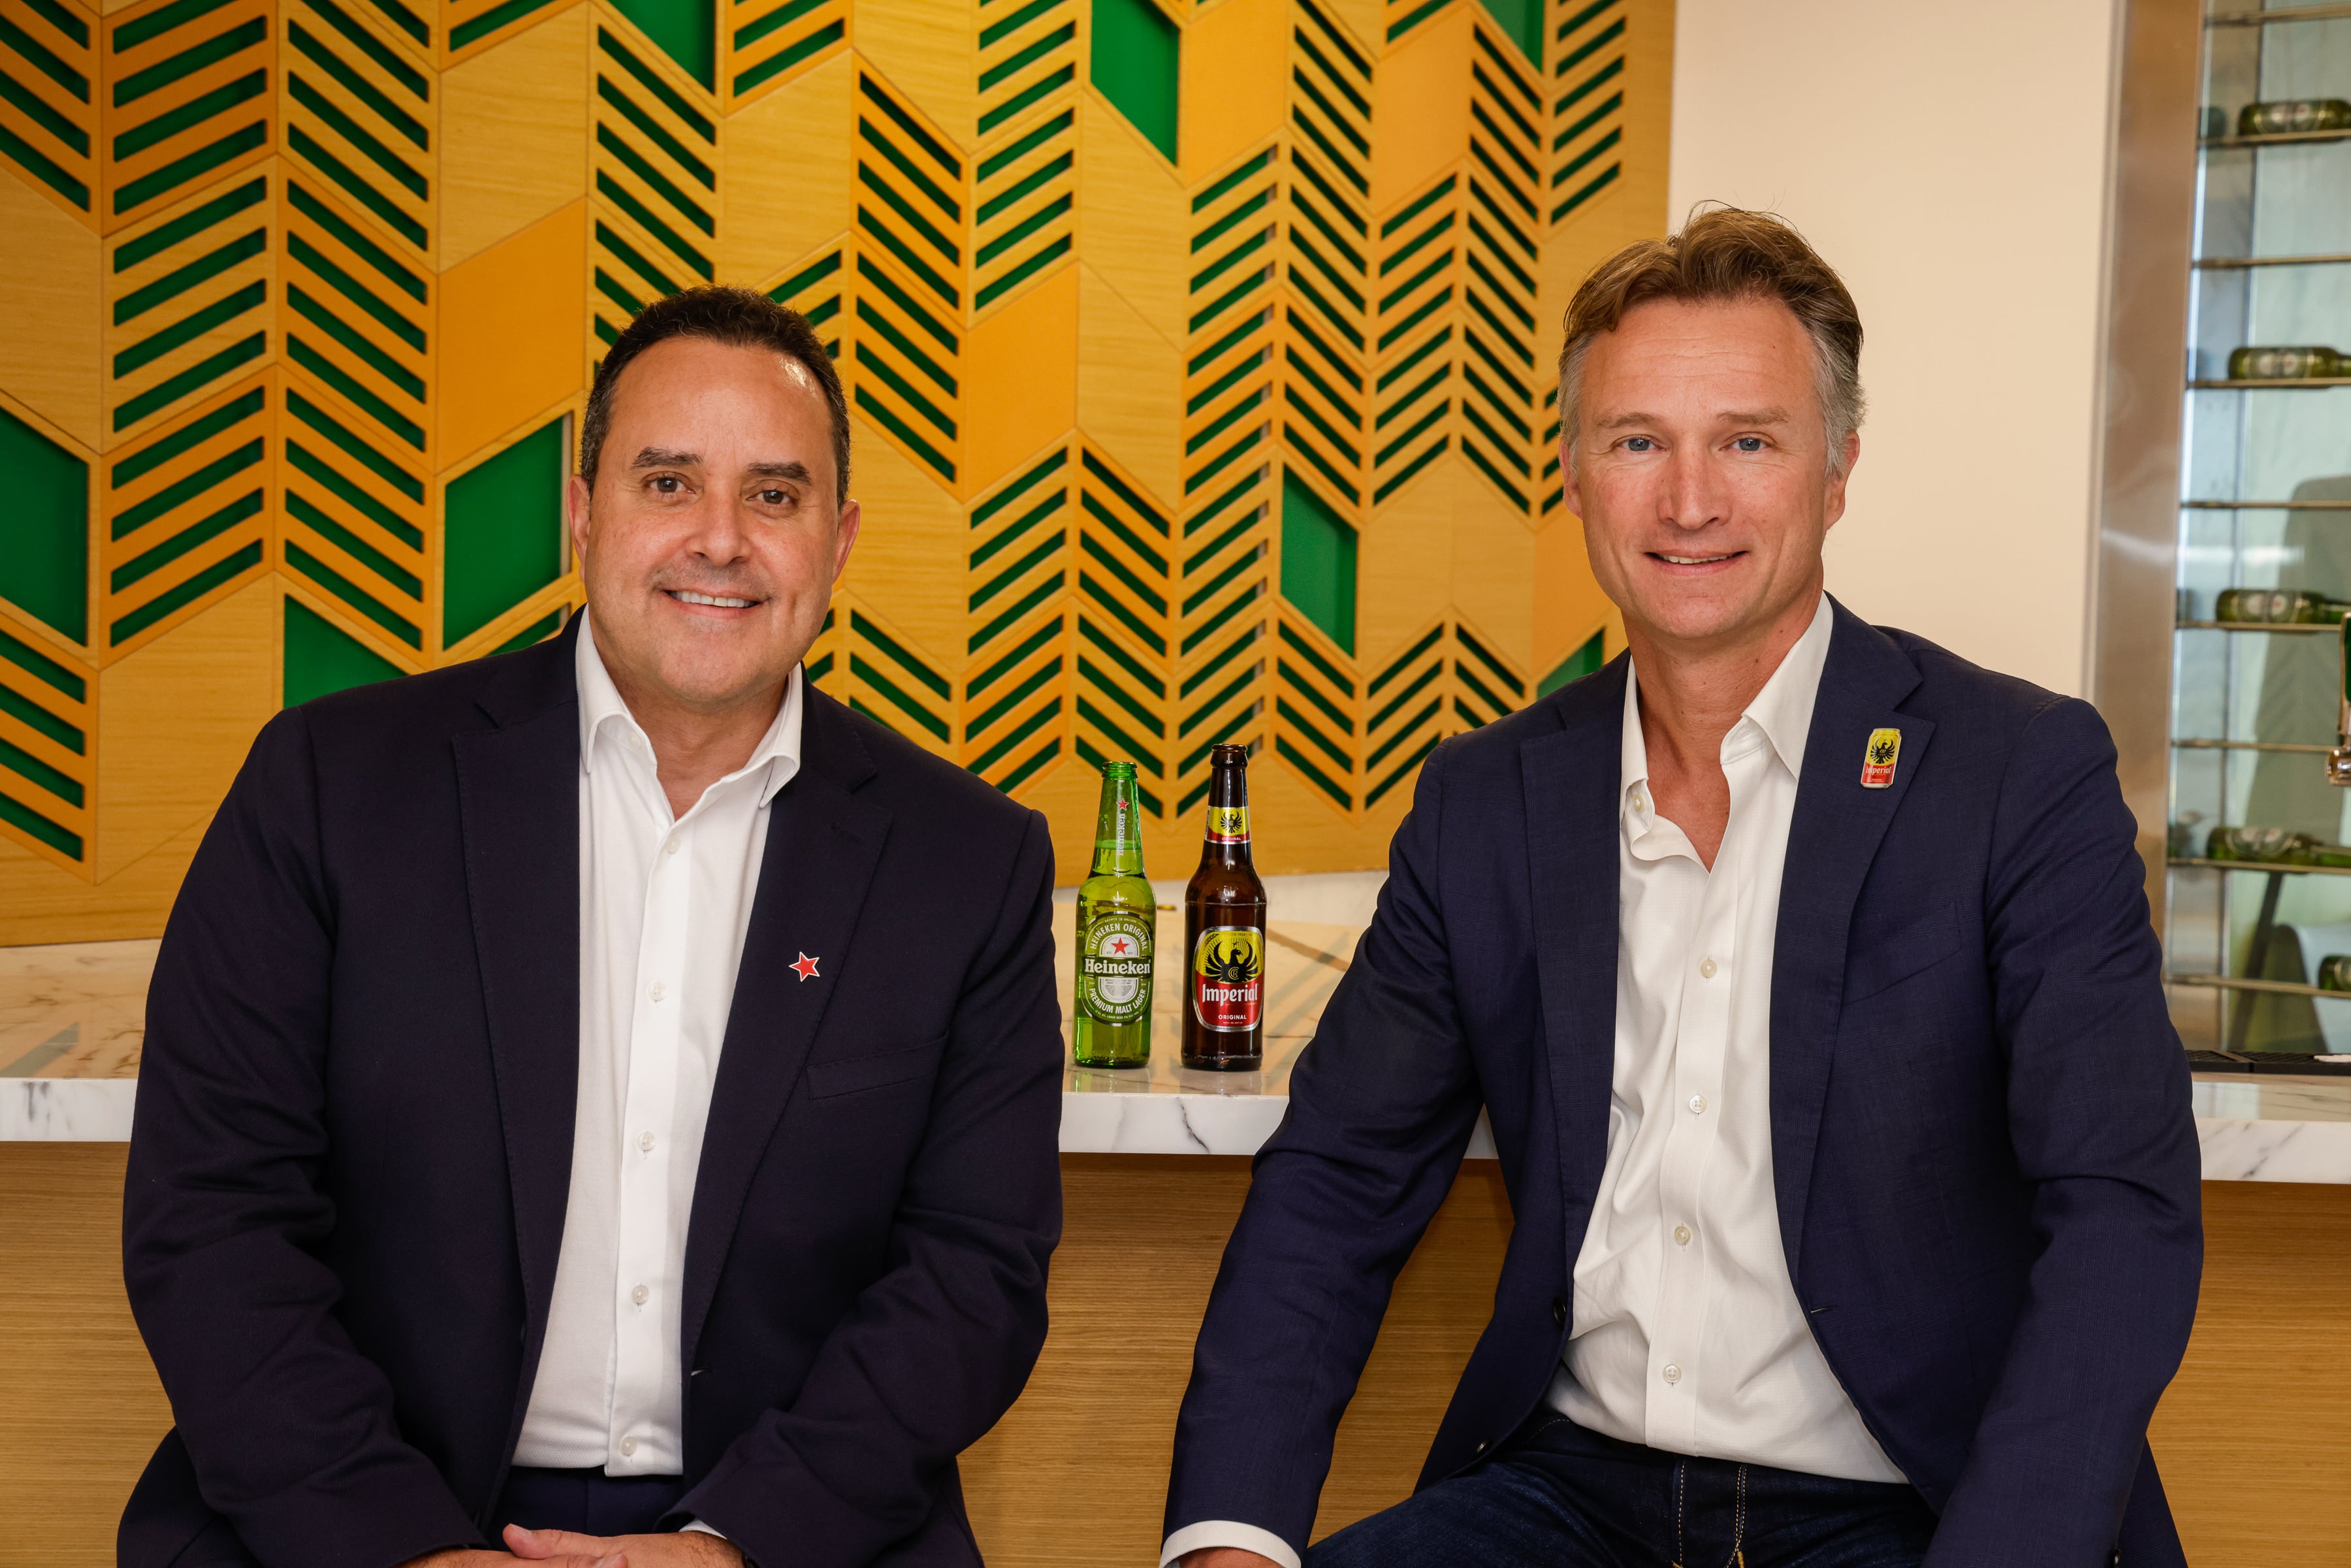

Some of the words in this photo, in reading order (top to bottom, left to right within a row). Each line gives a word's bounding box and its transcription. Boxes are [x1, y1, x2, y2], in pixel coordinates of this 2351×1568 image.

[1866, 766, 1891, 775] Imperial
[1091, 923, 1120, 950] HEINEKEN
[1123, 923, 1147, 951] ORIGINAL
[1085, 959, 1150, 974] Heineken
[1089, 987, 1113, 1014] PREMIUM
[1115, 1004, 1132, 1014] MALT
[1132, 989, 1146, 1009] LAGER
[1202, 983, 1258, 1006] Imperial
